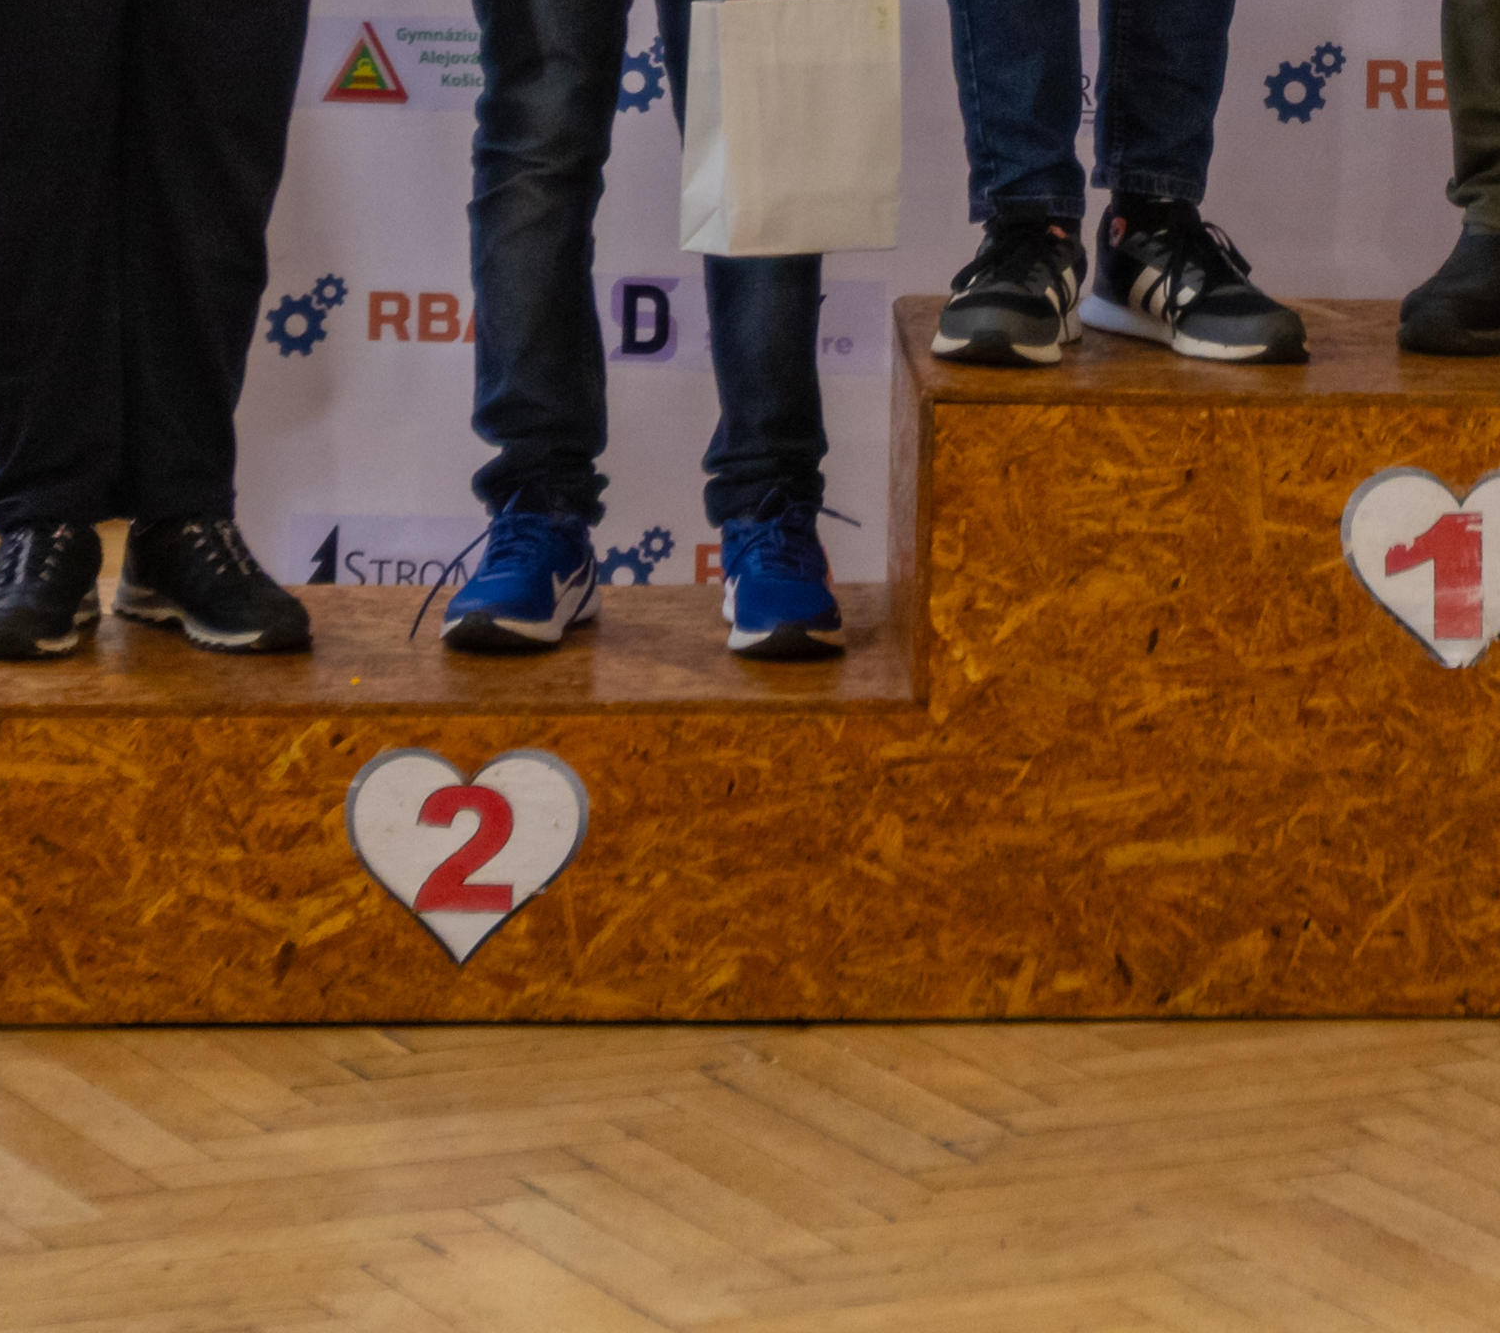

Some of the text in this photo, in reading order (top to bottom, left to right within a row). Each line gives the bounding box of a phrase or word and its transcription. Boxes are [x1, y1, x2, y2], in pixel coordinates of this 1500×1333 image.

[395, 27, 478, 46] Gymnáziu
[440, 71, 485, 89] Košic
[1366, 59, 1450, 110] RB
[368, 290, 476, 343] RB
[1384, 510, 1484, 641] 1
[413, 784, 515, 913] 2
